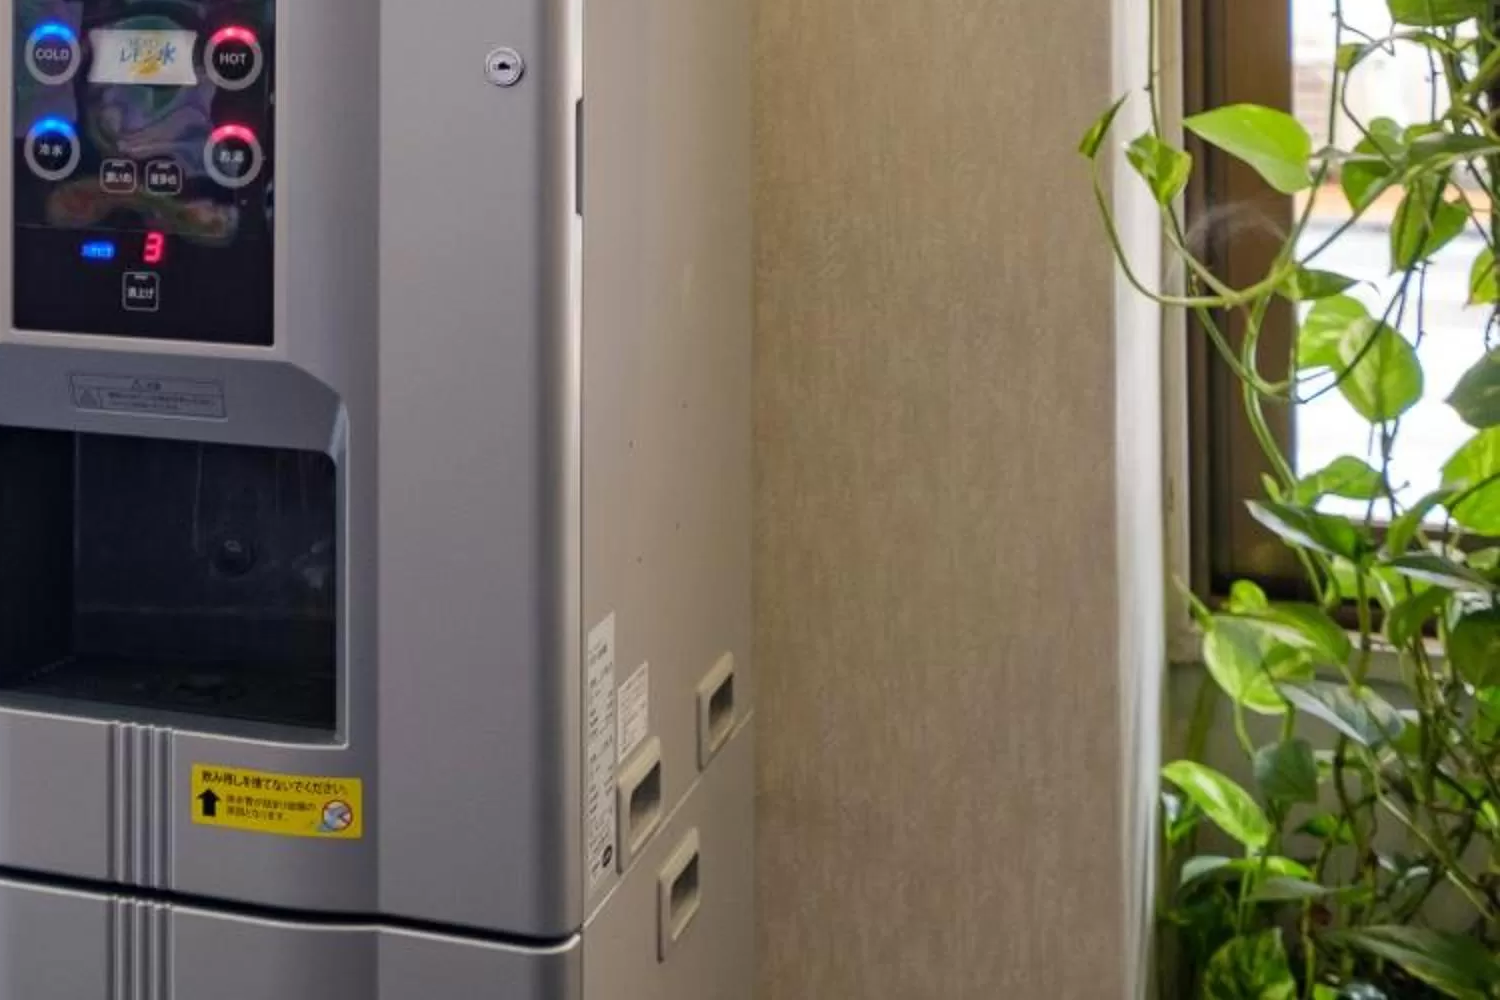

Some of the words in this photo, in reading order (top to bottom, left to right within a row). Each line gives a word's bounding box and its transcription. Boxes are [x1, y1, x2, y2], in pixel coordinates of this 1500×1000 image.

[35, 49, 69, 61] COLD
[219, 52, 246, 64] HOT
[143, 231, 165, 263] 3
